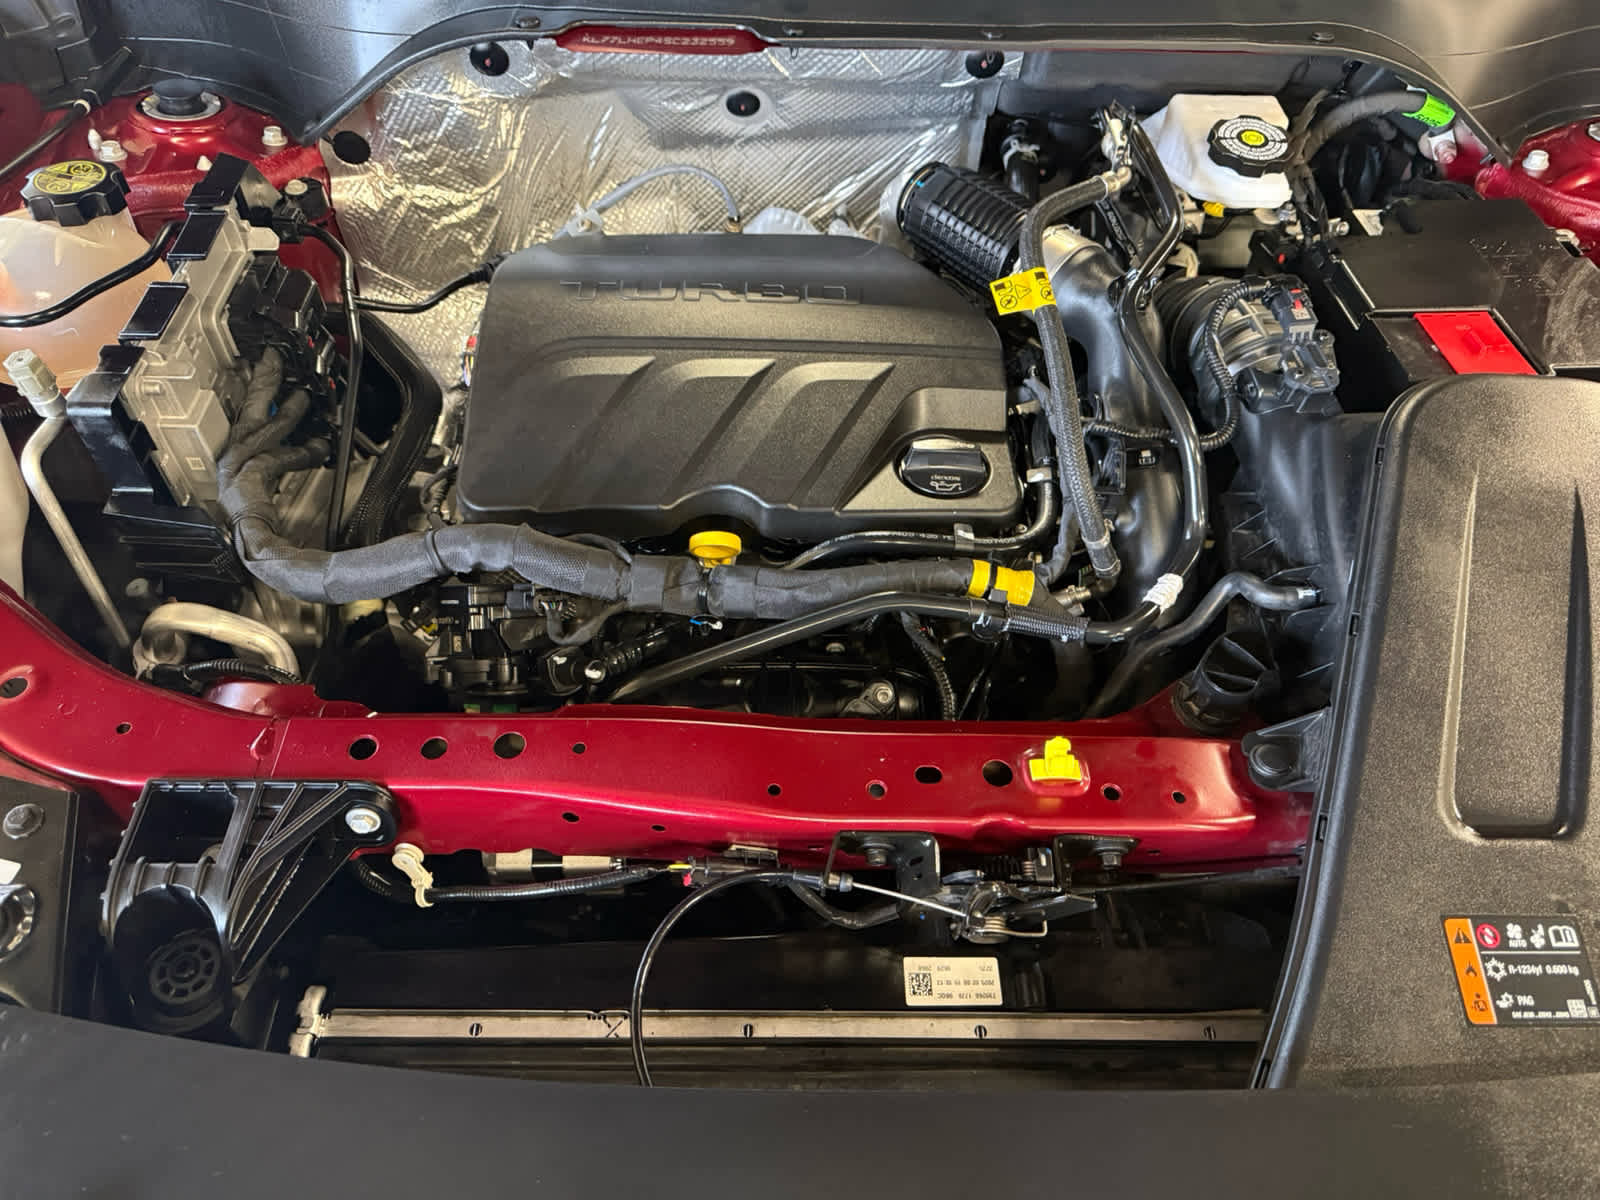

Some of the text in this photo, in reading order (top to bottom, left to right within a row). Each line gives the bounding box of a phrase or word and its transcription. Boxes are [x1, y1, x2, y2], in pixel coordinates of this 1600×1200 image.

[559, 279, 861, 304] TURBO
[1507, 964, 1543, 977] R-1234yf
[1516, 995, 1535, 1006] PAG
